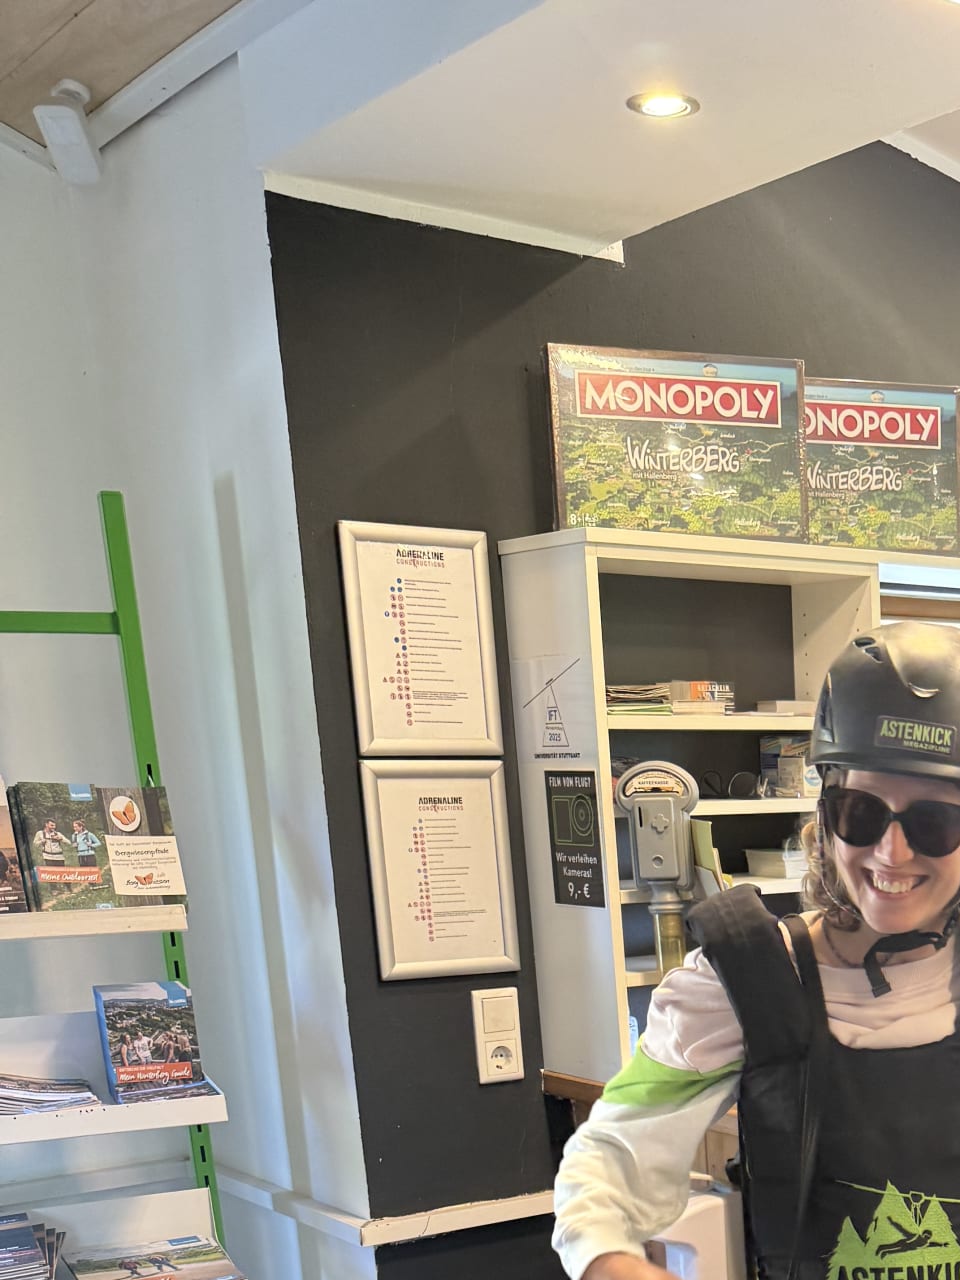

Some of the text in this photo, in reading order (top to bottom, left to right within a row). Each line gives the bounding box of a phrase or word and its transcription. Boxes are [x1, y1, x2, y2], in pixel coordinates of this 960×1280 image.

[585, 378, 774, 419] MONOPOLY
[805, 407, 935, 442] ONOPOLY
[626, 436, 740, 474] WINTERBERG
[396, 549, 444, 561] ADRENALINE
[880, 719, 952, 746] ASTENKICK
[548, 776, 561, 788] FILM
[575, 776, 591, 788] FLUG?
[418, 796, 463, 805] ADRENALINE
[555, 851, 597, 864] Wir verleihen
[562, 866, 592, 878] Kameras!
[583, 883, 591, 898] €
